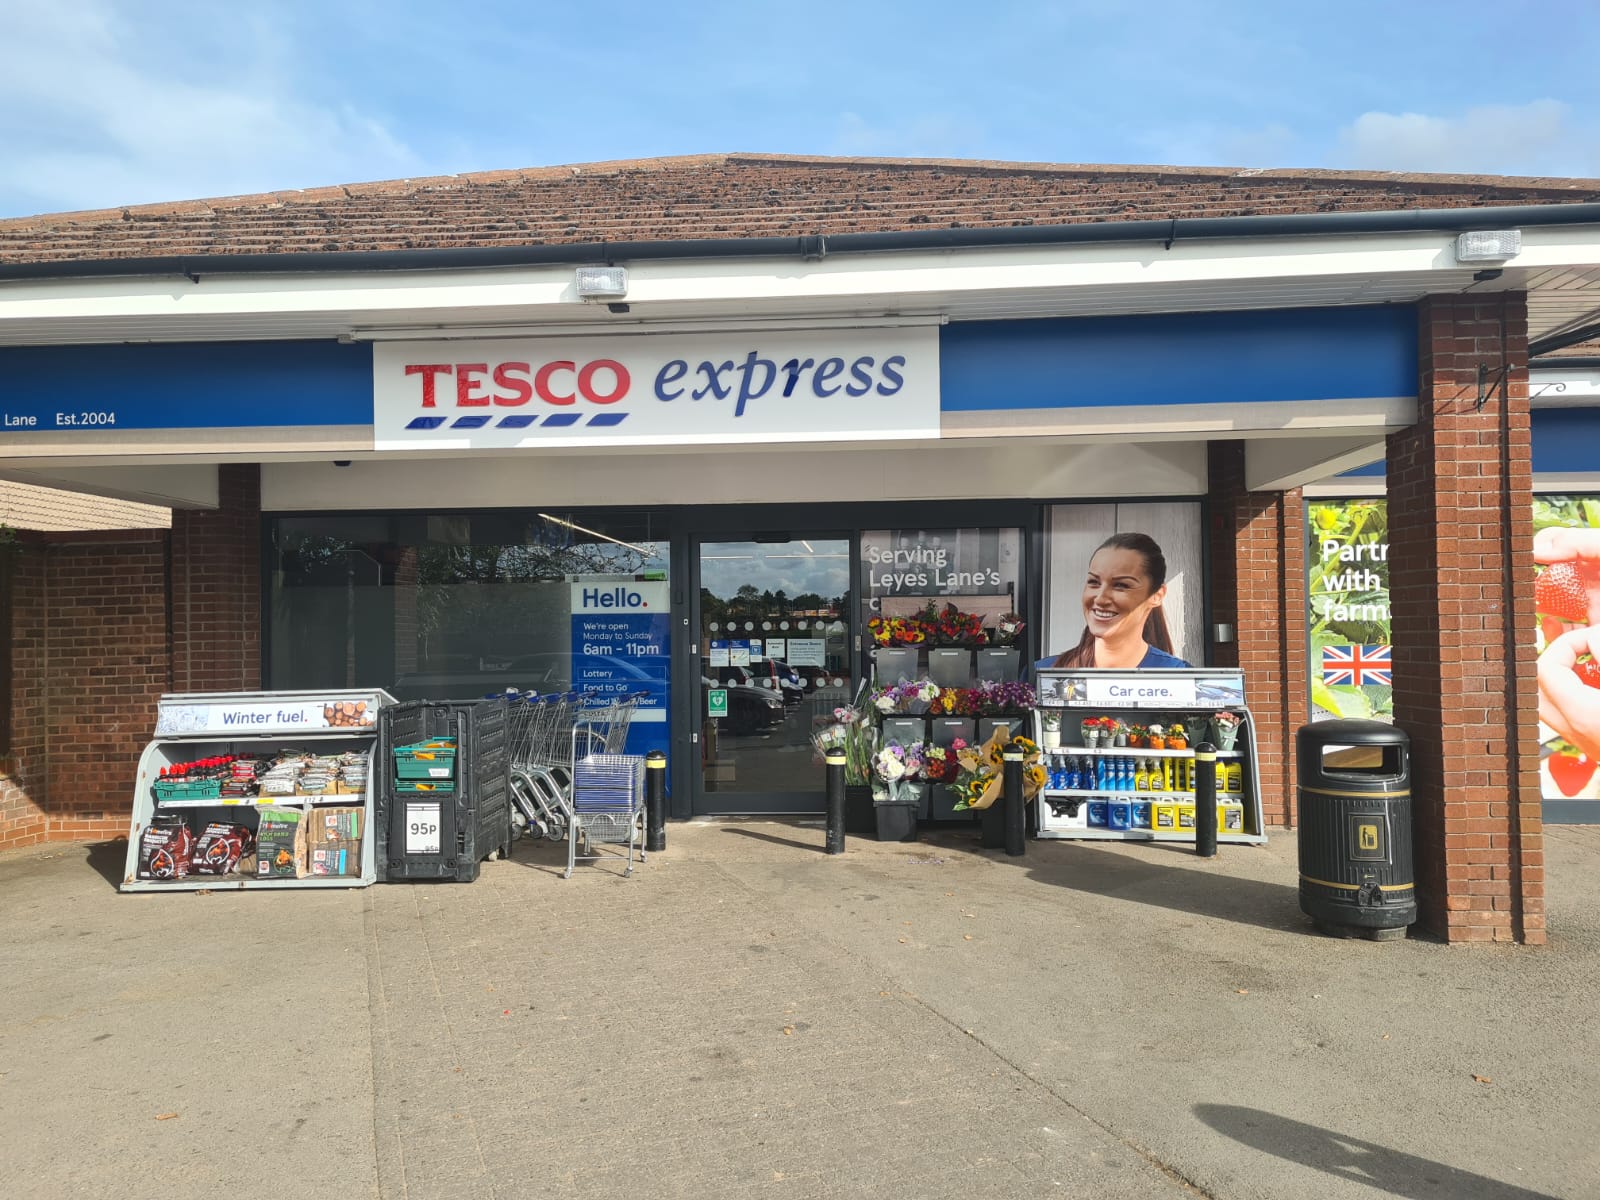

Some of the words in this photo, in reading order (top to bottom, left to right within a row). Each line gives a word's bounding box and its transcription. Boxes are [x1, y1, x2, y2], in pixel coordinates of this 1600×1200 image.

[405, 360, 631, 408] TESCO
[654, 350, 906, 417] express
[4, 413, 37, 427] Lane
[56, 412, 115, 426] Est.2004
[869, 546, 947, 567] Serving
[869, 570, 928, 591] Leyes
[935, 568, 1001, 586] Lane's
[1322, 568, 1381, 592] with
[583, 588, 648, 608] Hello.
[1323, 599, 1392, 622] farm
[608, 624, 629, 632] open
[583, 643, 612, 655] 6am
[626, 643, 659, 657] 11pm
[583, 670, 613, 678] Lottery
[1109, 685, 1134, 697] Car
[1137, 686, 1173, 697] care.
[583, 697, 610, 706] Chilled
[223, 711, 272, 725] Winter
[276, 709, 308, 723] fuel.
